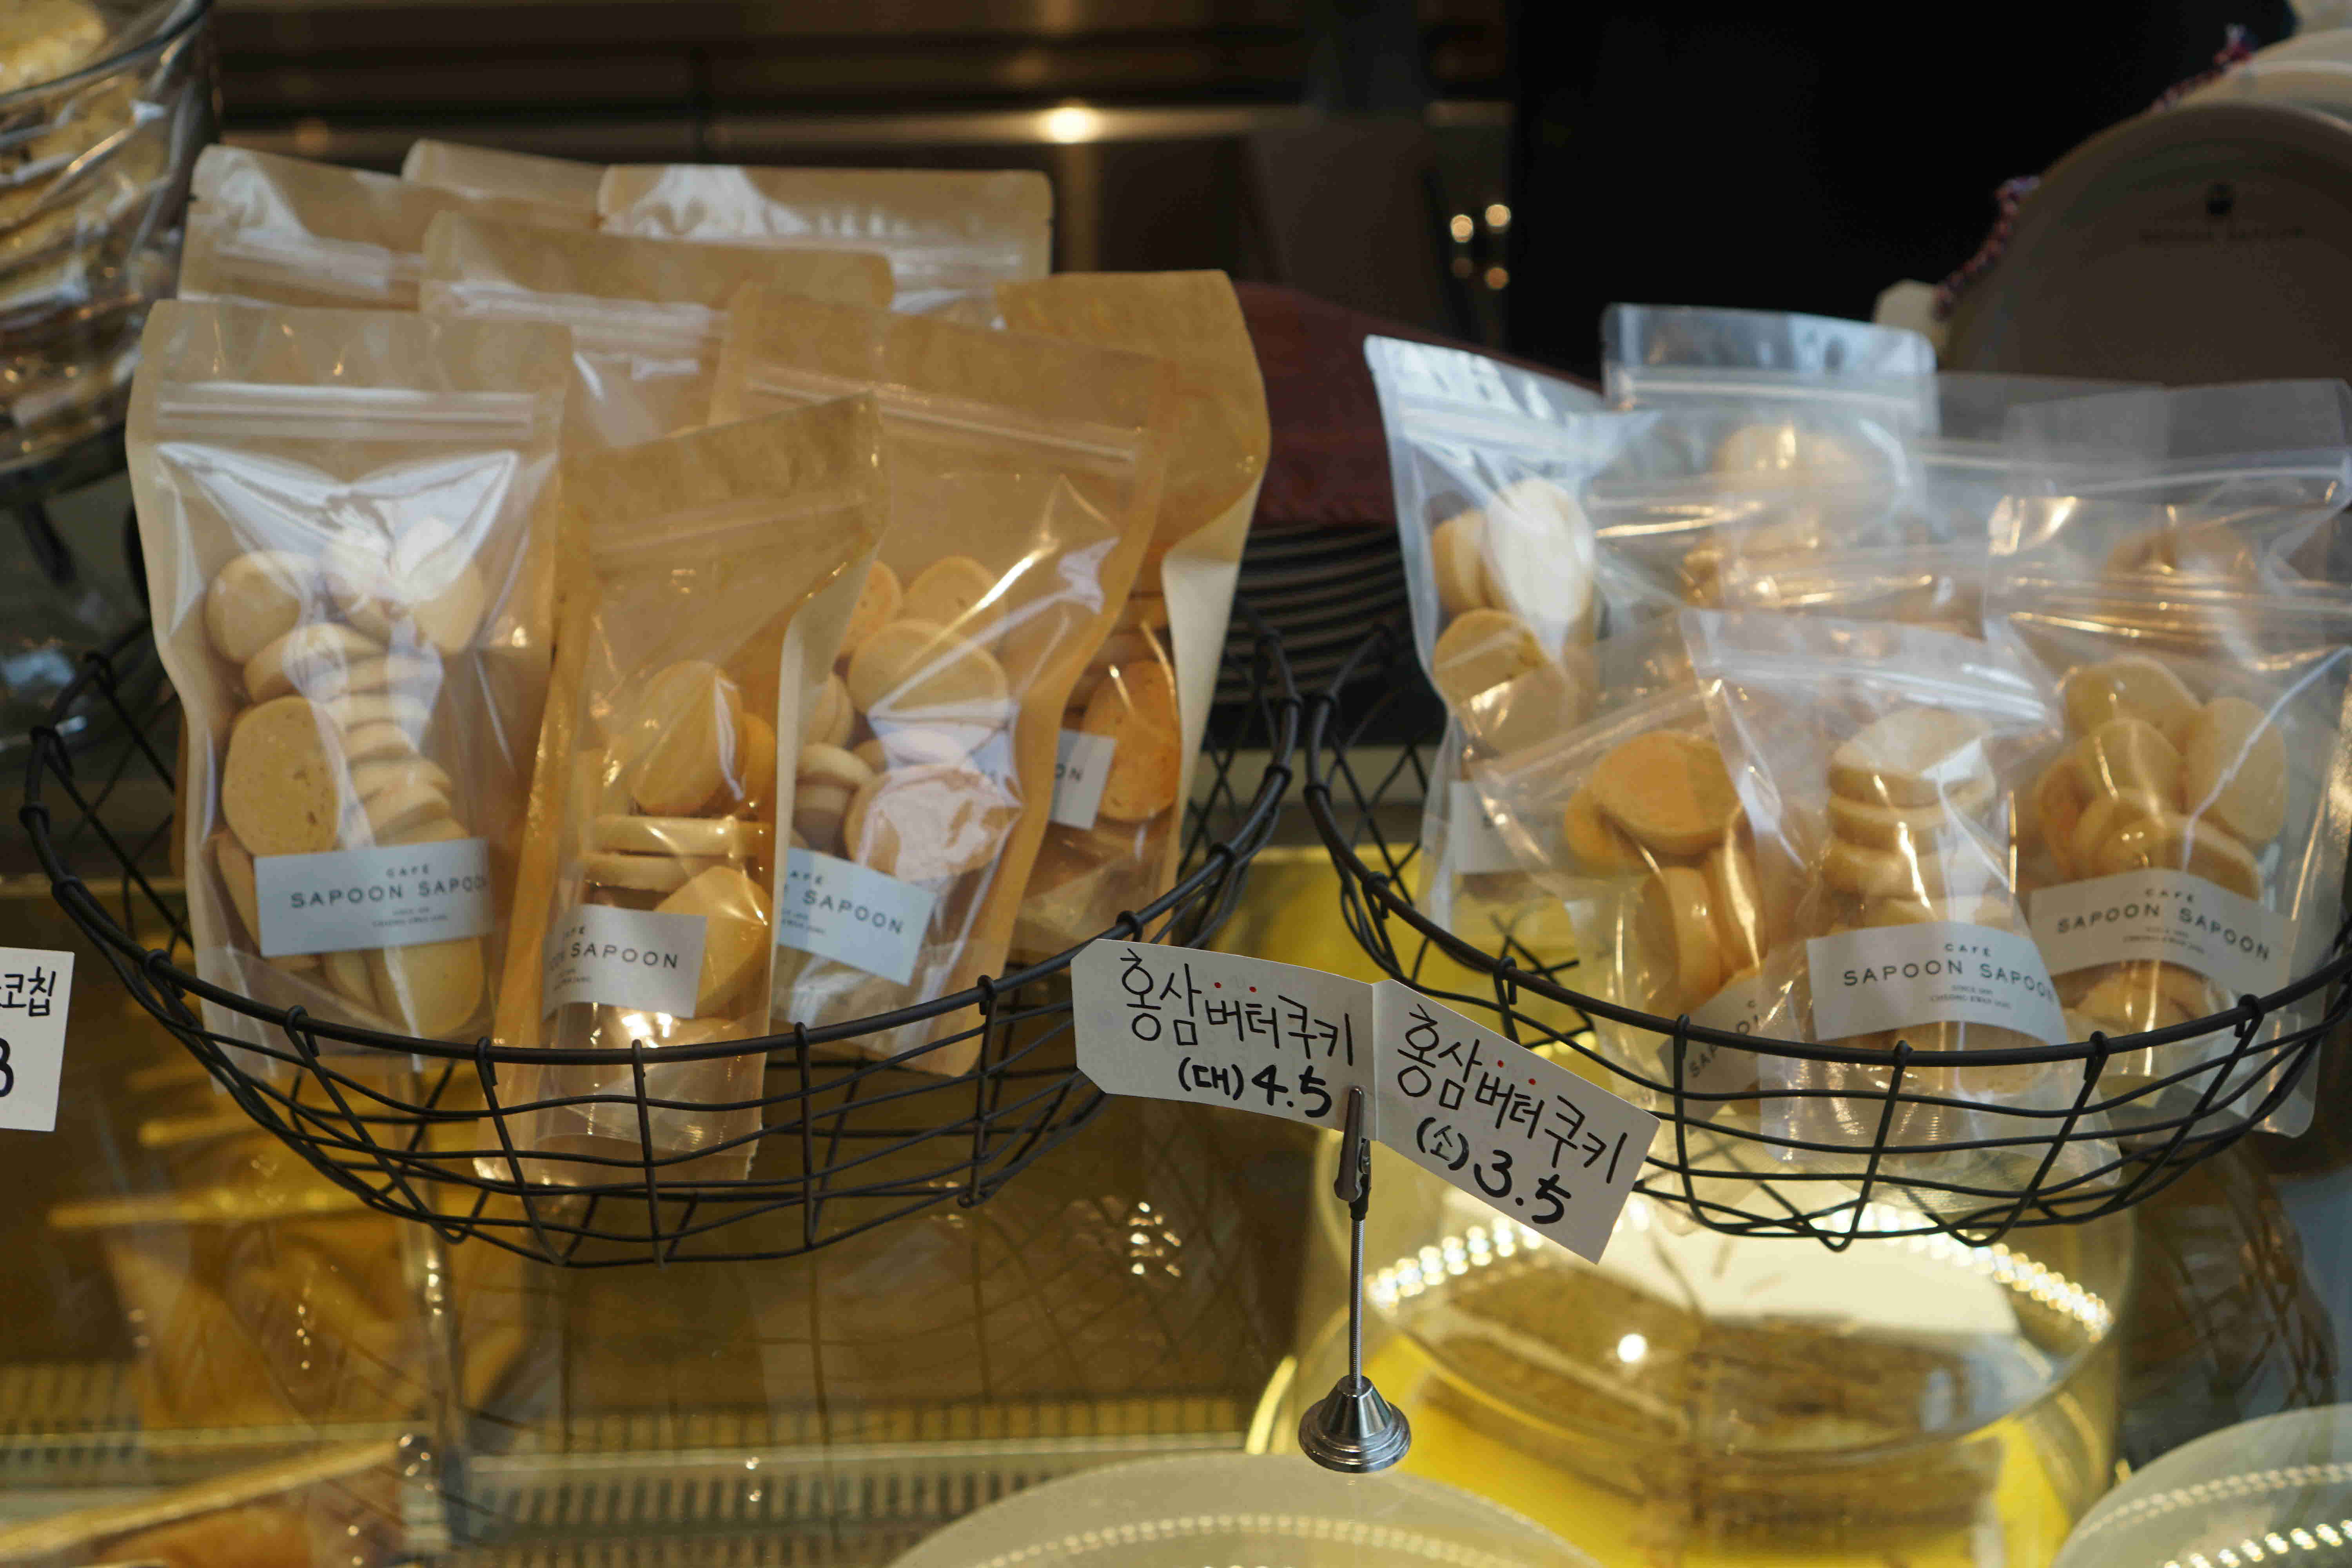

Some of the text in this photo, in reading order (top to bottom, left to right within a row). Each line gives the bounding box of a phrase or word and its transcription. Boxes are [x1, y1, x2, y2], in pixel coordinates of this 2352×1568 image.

[290, 883, 403, 909] SAPOON
[802, 890, 905, 934] SAPOON
[2056, 902, 2160, 934] SAPOON
[2178, 907, 2271, 960] SAPOON
[570, 942, 679, 970] SAPOON
[1843, 959, 1964, 986] SAPOON
[0, 965, 56, 1017] 코칩
[1118, 947, 1354, 1067] 홍삼버터쿠키
[1396, 1003, 1629, 1185] 홍삼버터쿠키
